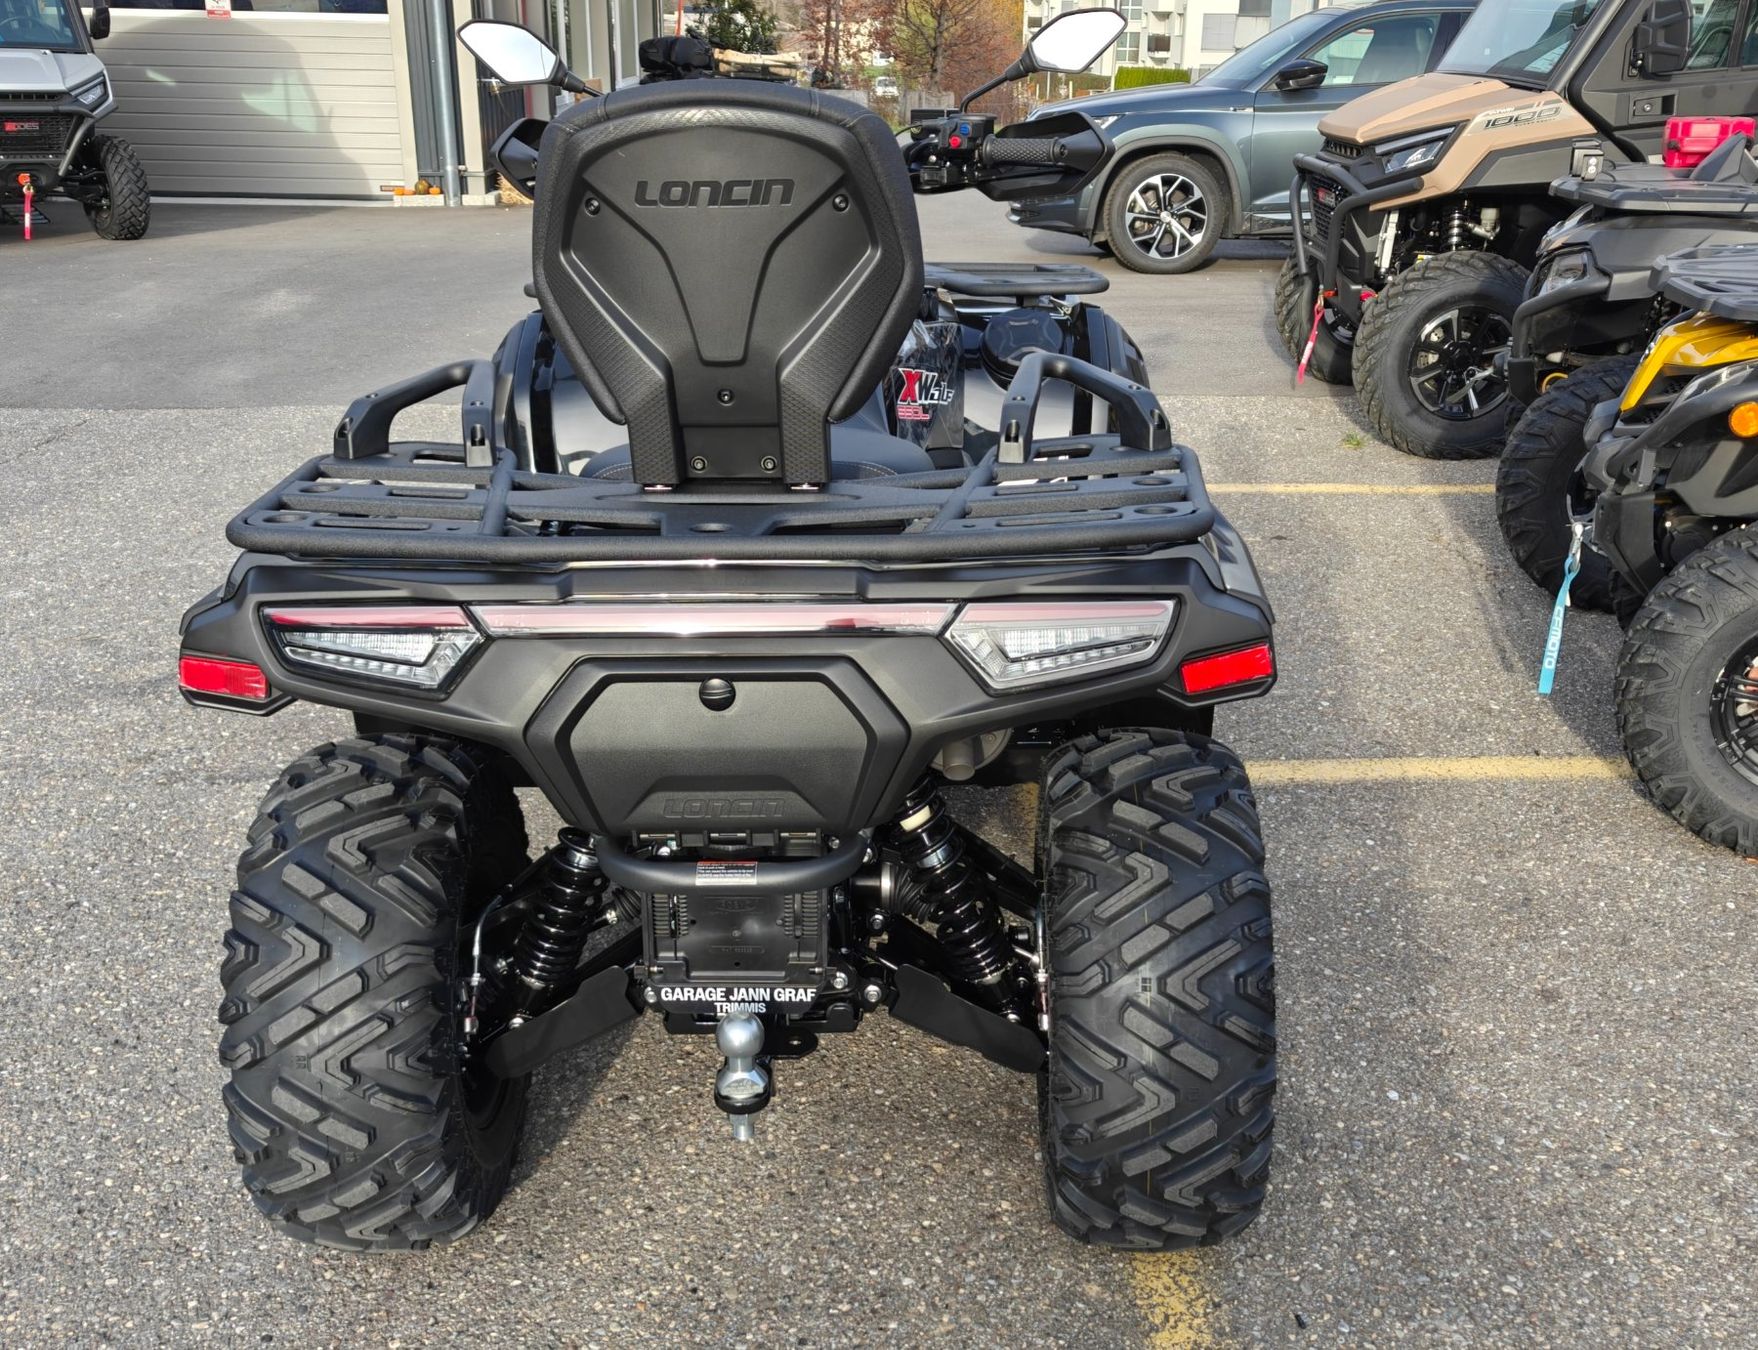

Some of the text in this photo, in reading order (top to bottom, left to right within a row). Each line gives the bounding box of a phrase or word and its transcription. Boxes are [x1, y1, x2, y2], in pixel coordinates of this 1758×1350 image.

[1484, 107, 1562, 129] 1000
[634, 179, 795, 208] LONCIN
[1544, 605, 1563, 669] CFMOTO
[663, 799, 786, 818] LONCIN
[660, 988, 817, 1002] GARAGE JANN GRAF
[714, 1002, 767, 1014] TRIMMIS
